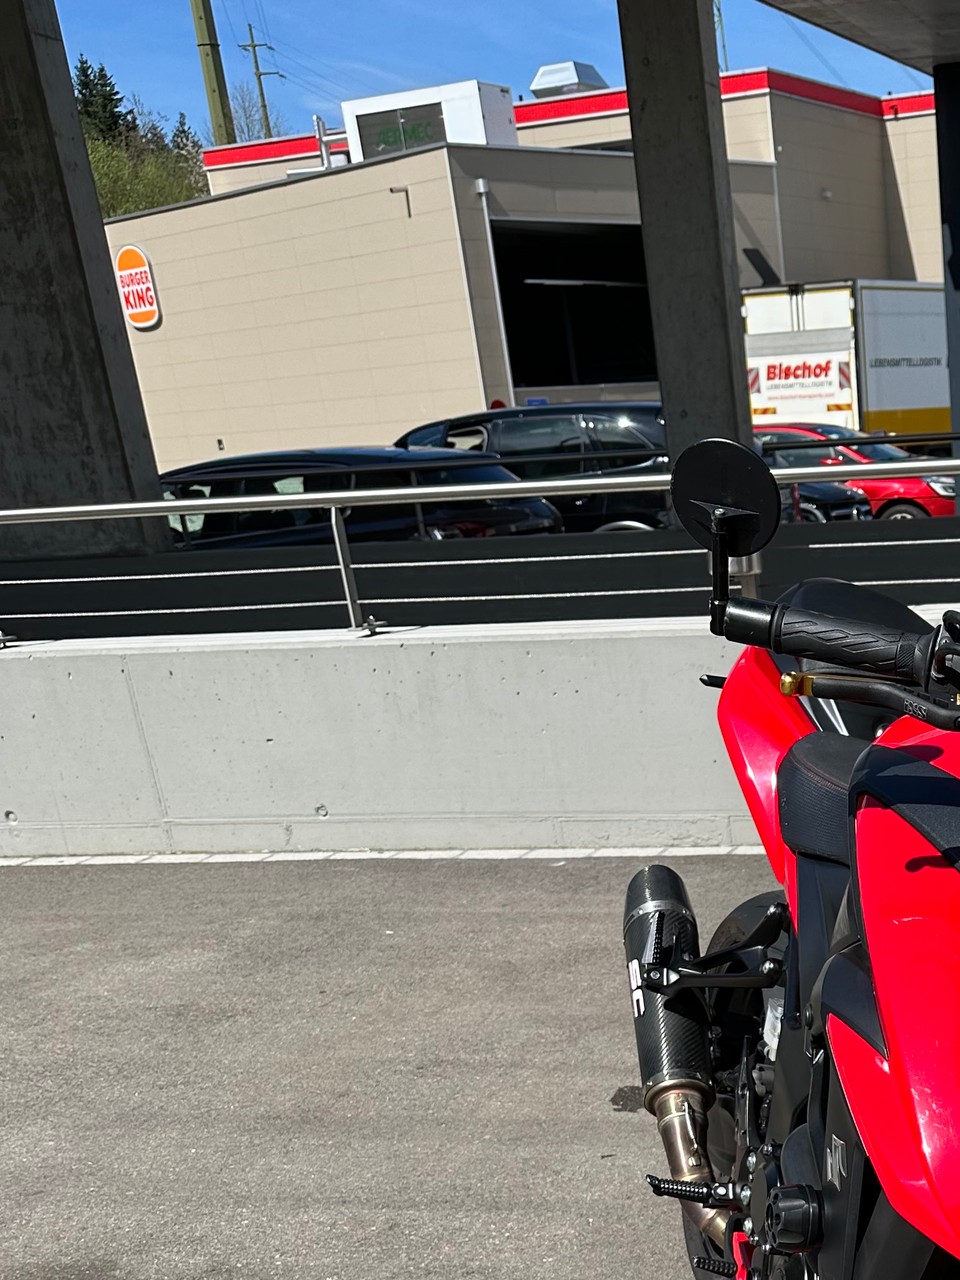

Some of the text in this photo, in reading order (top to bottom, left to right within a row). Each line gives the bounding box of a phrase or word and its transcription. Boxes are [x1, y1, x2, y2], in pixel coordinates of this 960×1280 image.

[119, 270, 151, 289] BURGER
[123, 286, 154, 311] KING
[766, 360, 832, 382] Bischof
